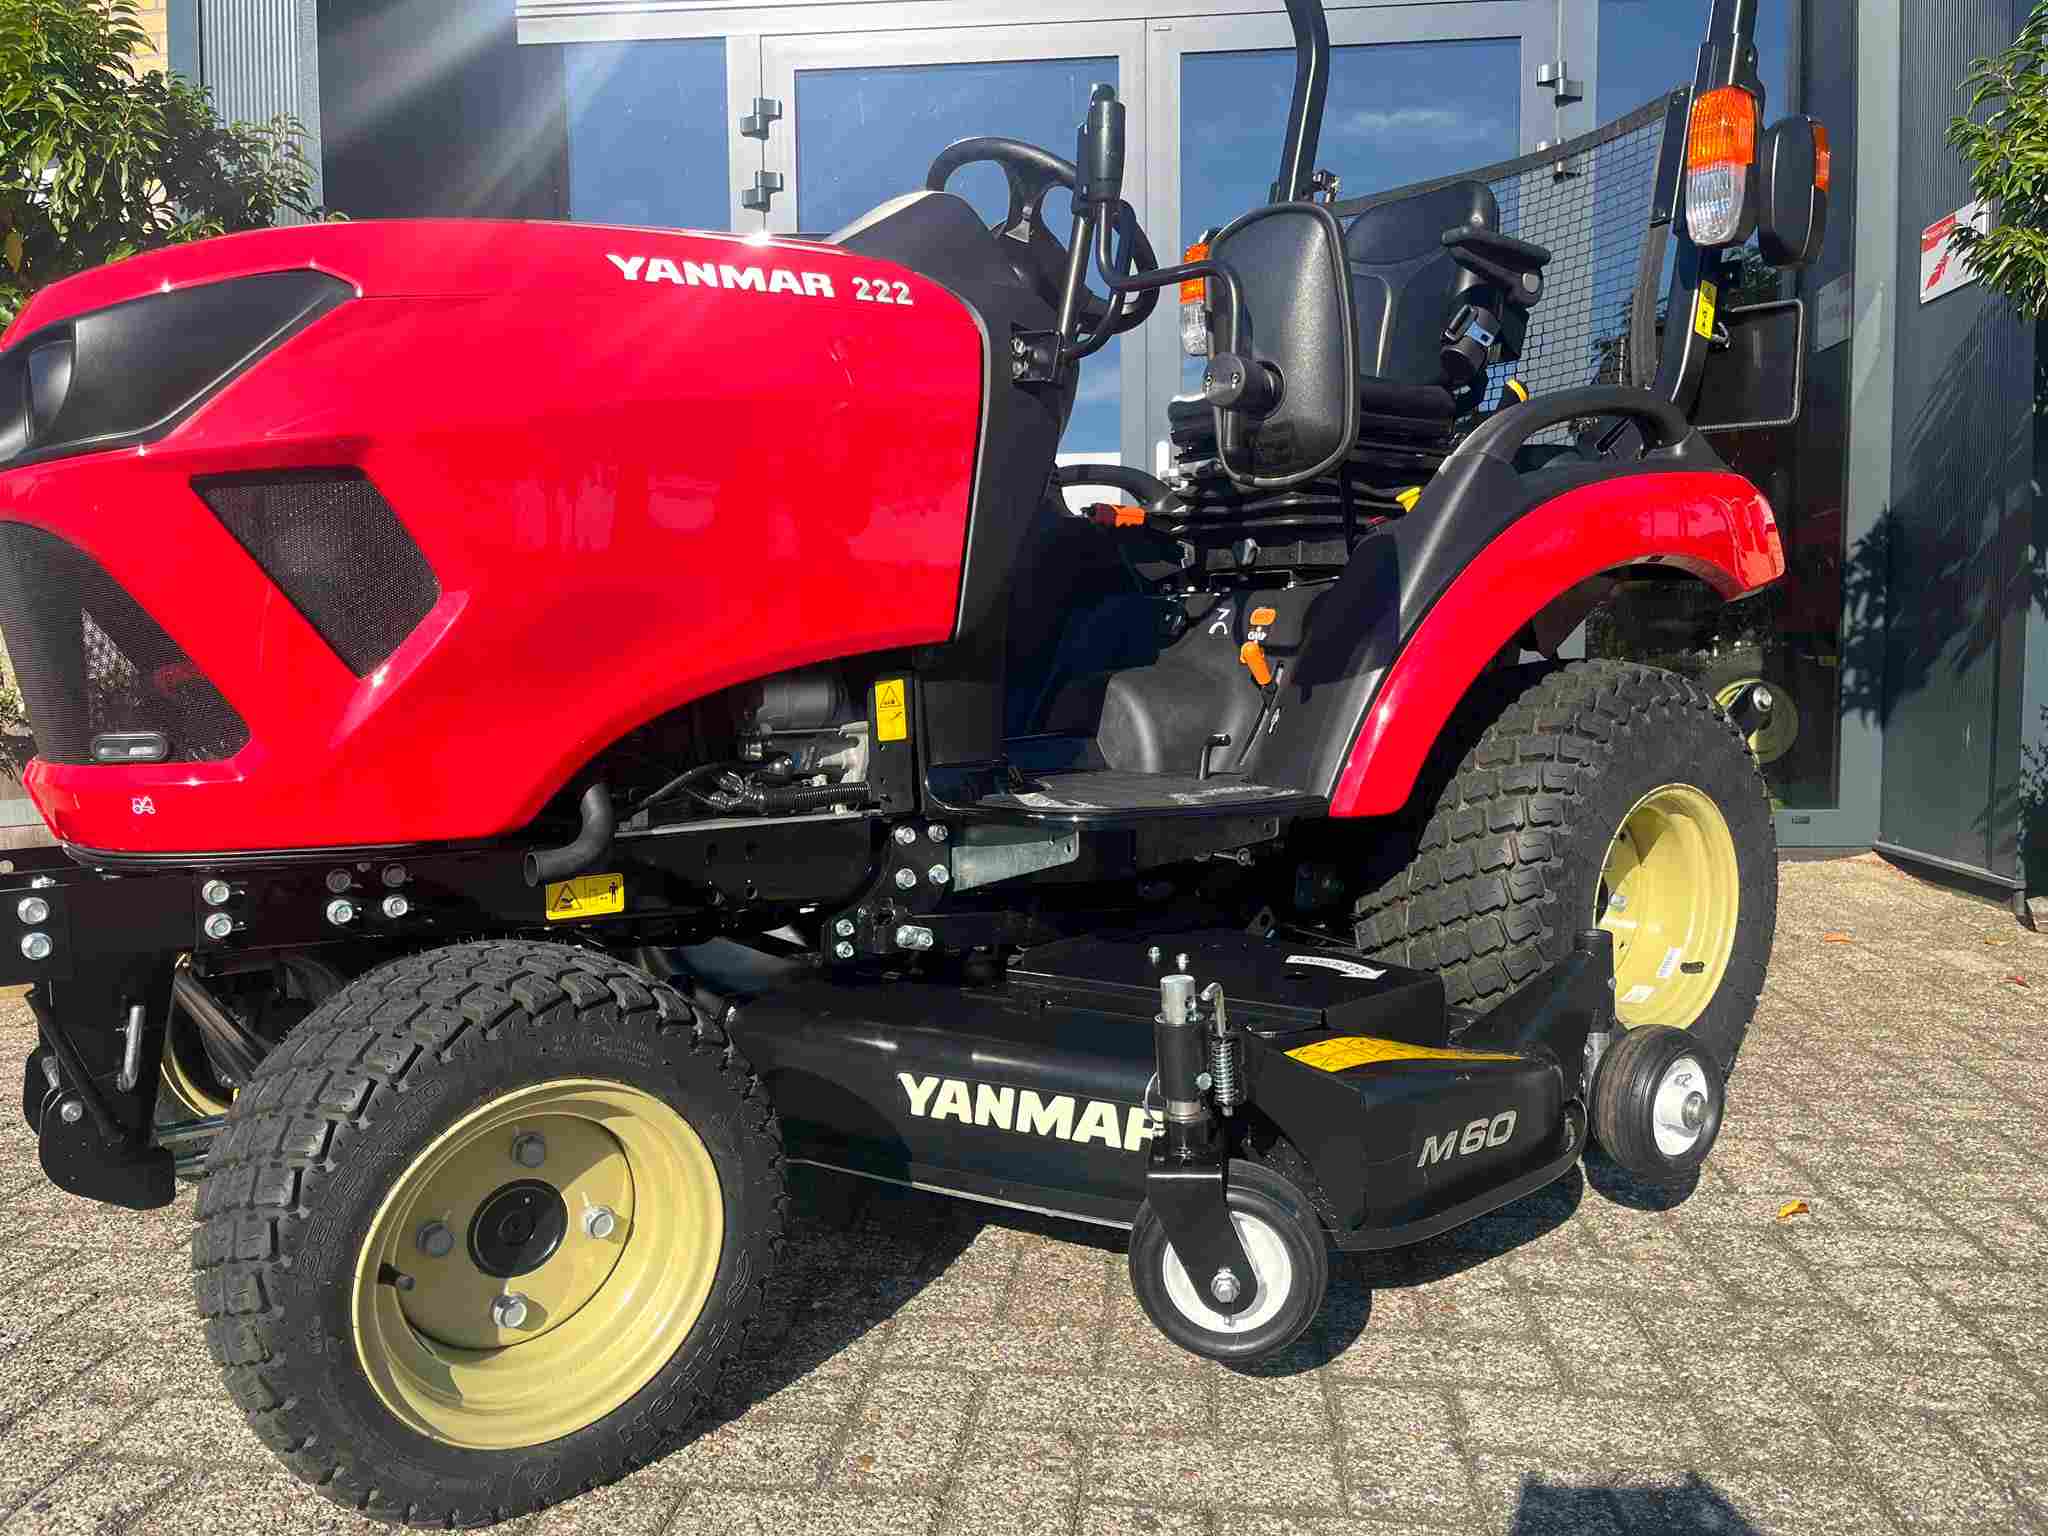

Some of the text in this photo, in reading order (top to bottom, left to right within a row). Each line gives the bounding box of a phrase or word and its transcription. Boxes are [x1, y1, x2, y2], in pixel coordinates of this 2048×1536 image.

[605, 254, 913, 306] YANMAR 222
[1417, 1110, 1517, 1168] M60
